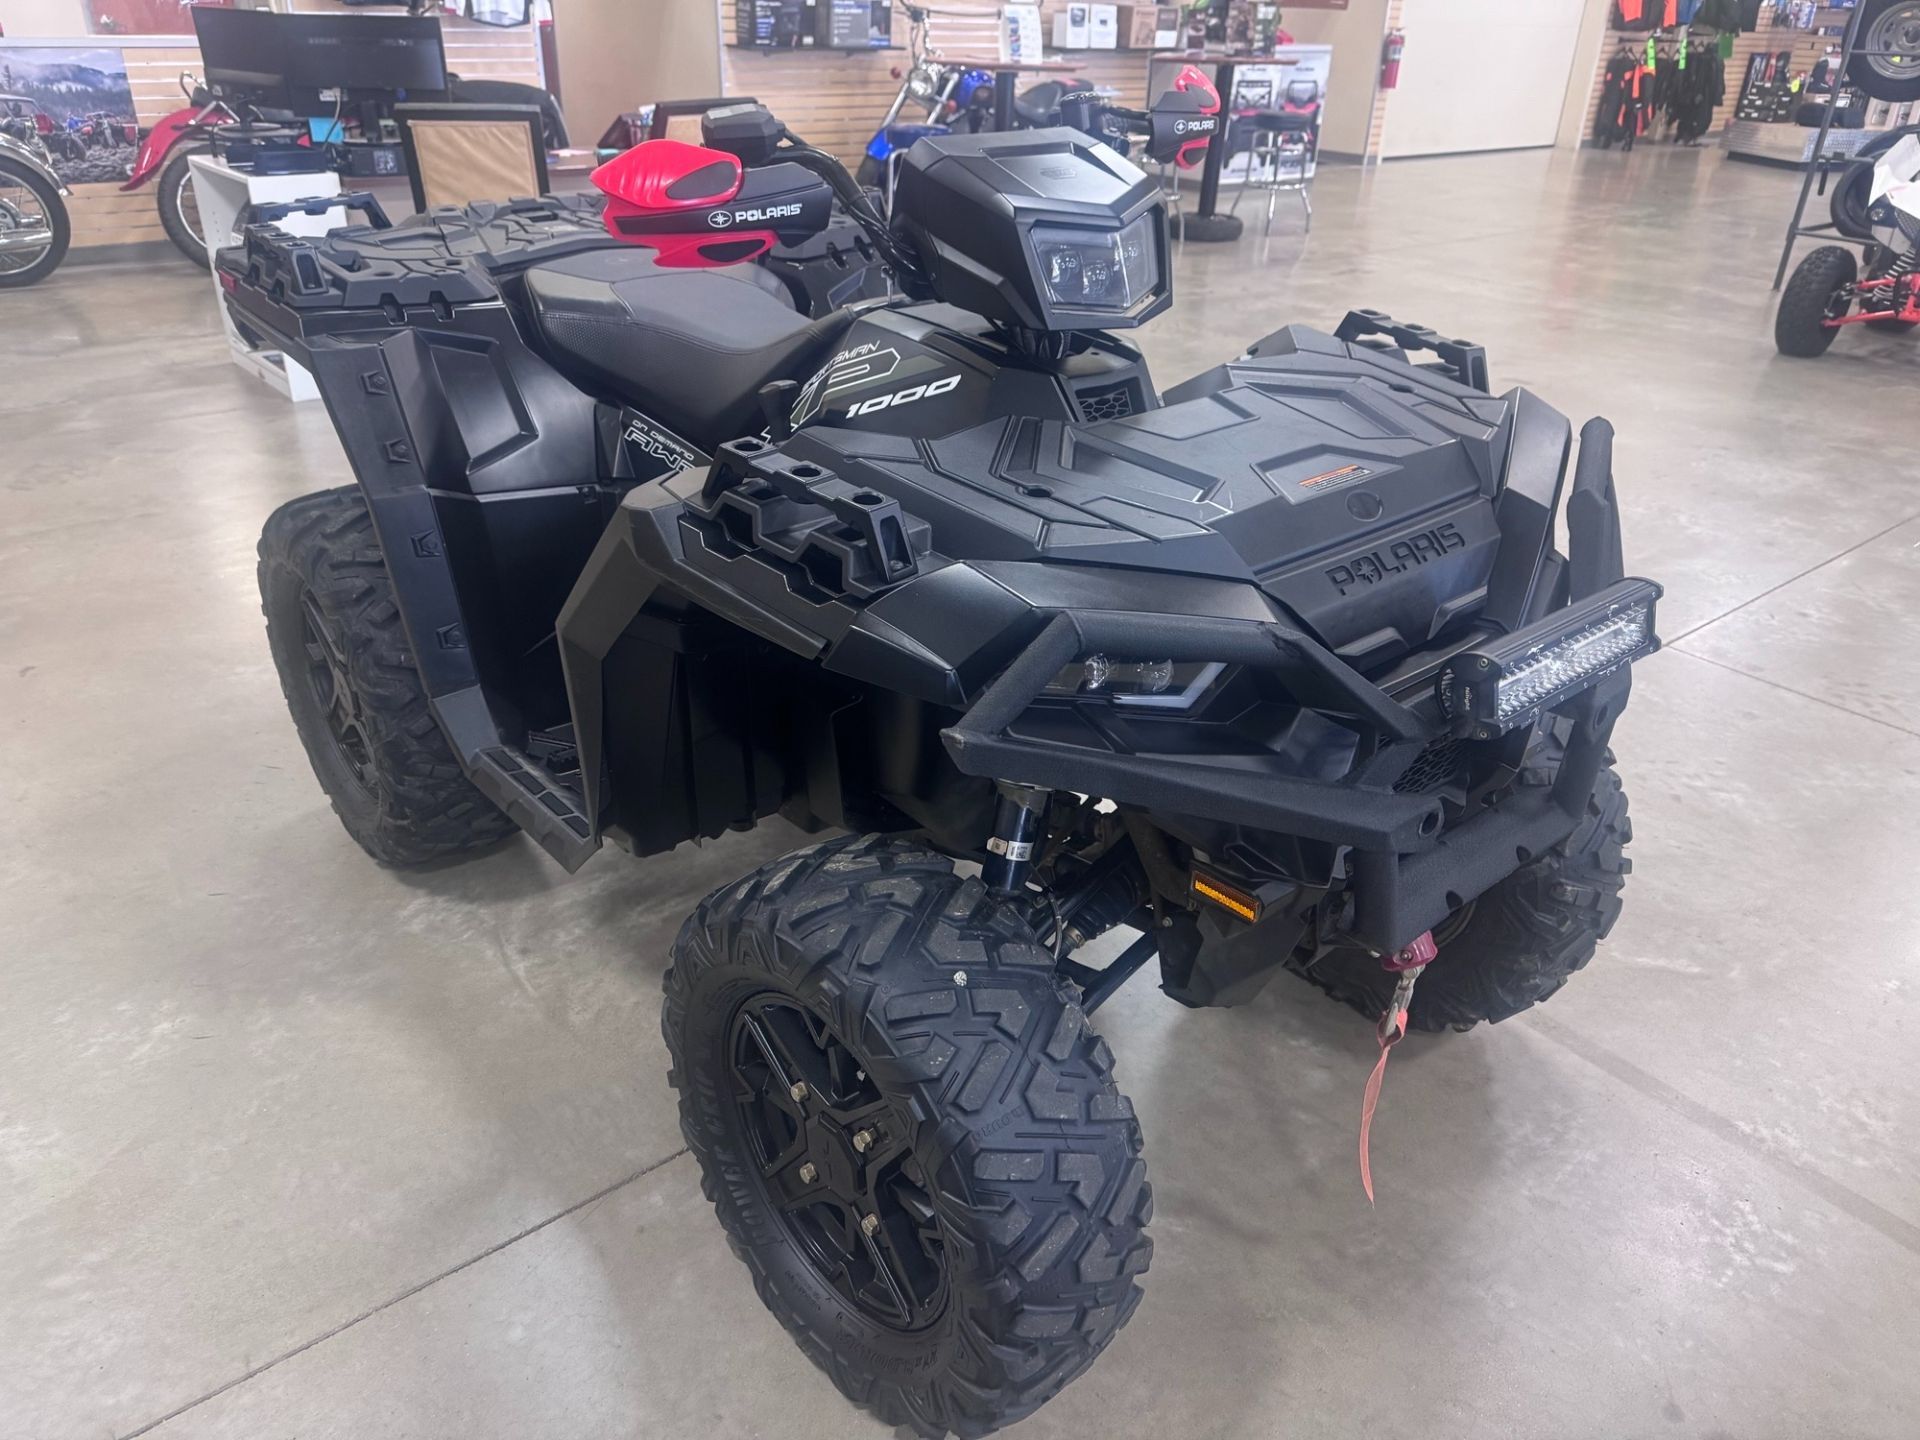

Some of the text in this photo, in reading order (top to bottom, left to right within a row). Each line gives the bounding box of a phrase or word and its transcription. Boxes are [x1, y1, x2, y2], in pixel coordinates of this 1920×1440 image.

[1187, 120, 1215, 131] POLARIS
[735, 203, 802, 223] POLARIS
[800, 340, 880, 397] SPORTSMAN
[846, 374, 962, 419] 1000
[1325, 522, 1466, 597] POLARIS
